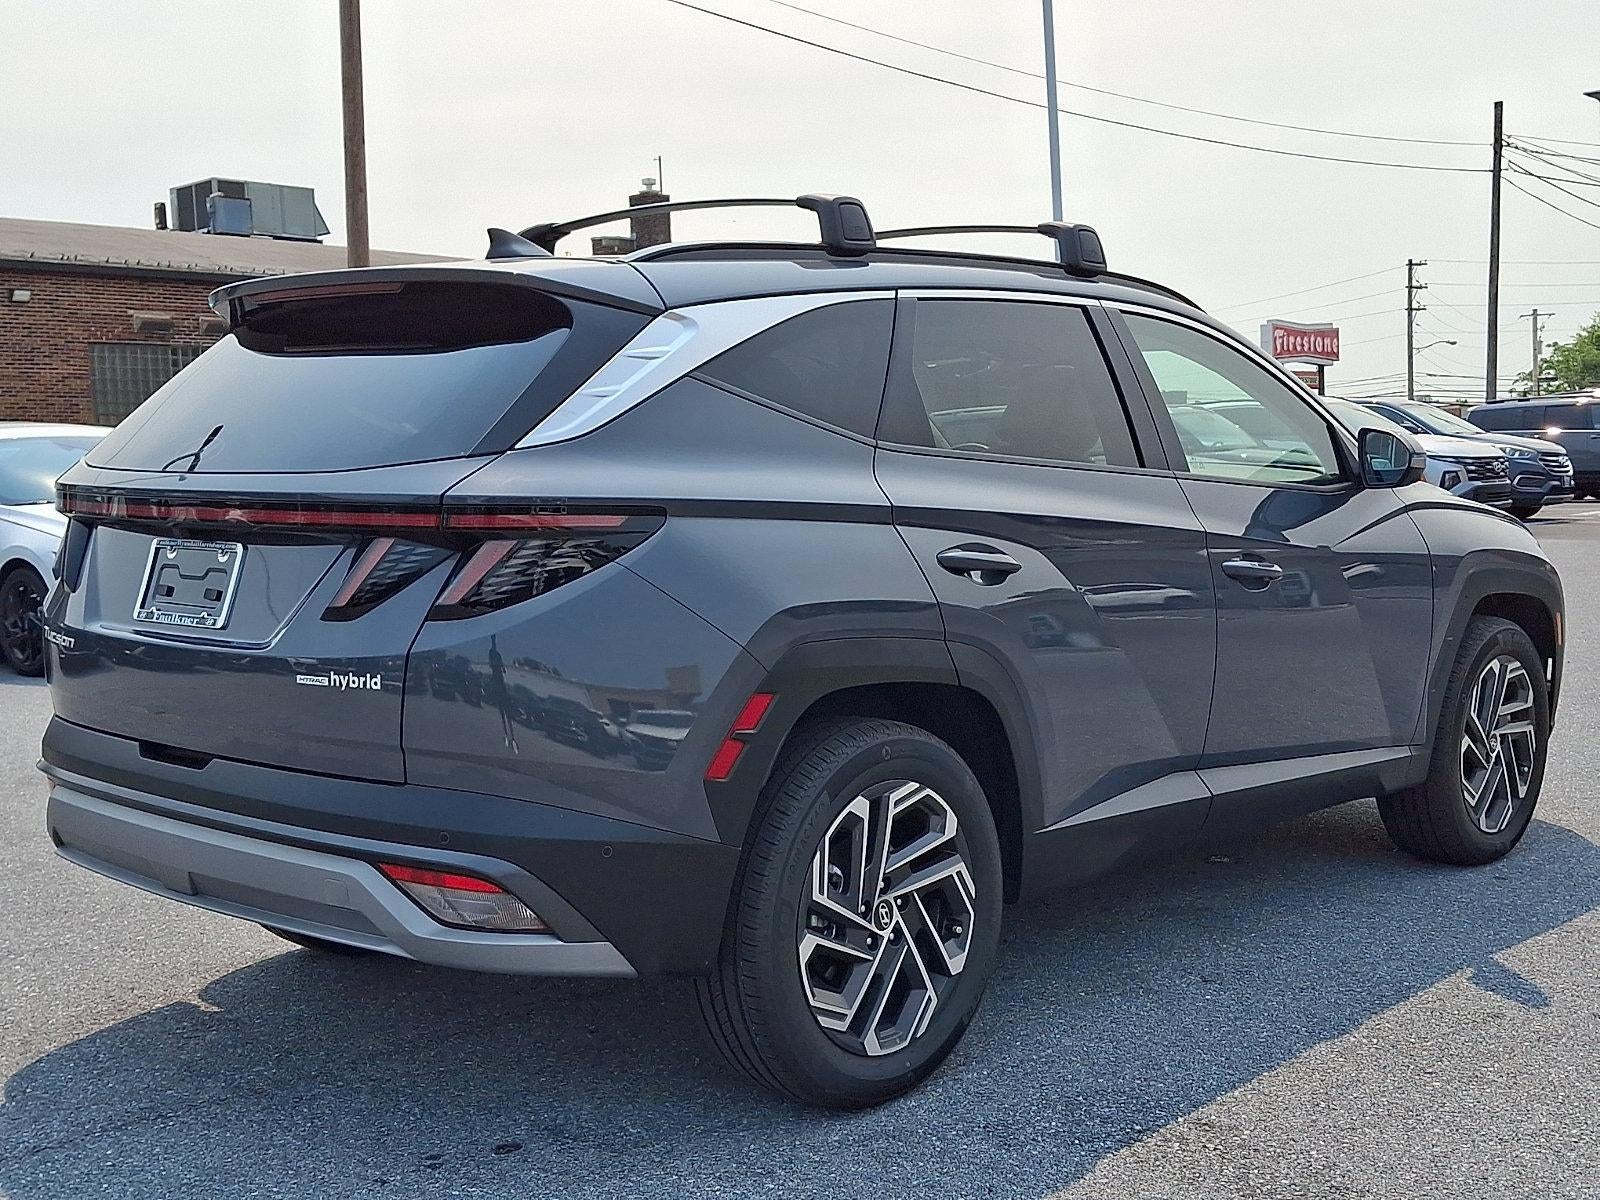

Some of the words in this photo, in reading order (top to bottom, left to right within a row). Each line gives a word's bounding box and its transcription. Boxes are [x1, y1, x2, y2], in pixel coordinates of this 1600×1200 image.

[1274, 329, 1338, 353] Firestone
[153, 611, 200, 625] Faulkner
[330, 670, 381, 691] hybrid
